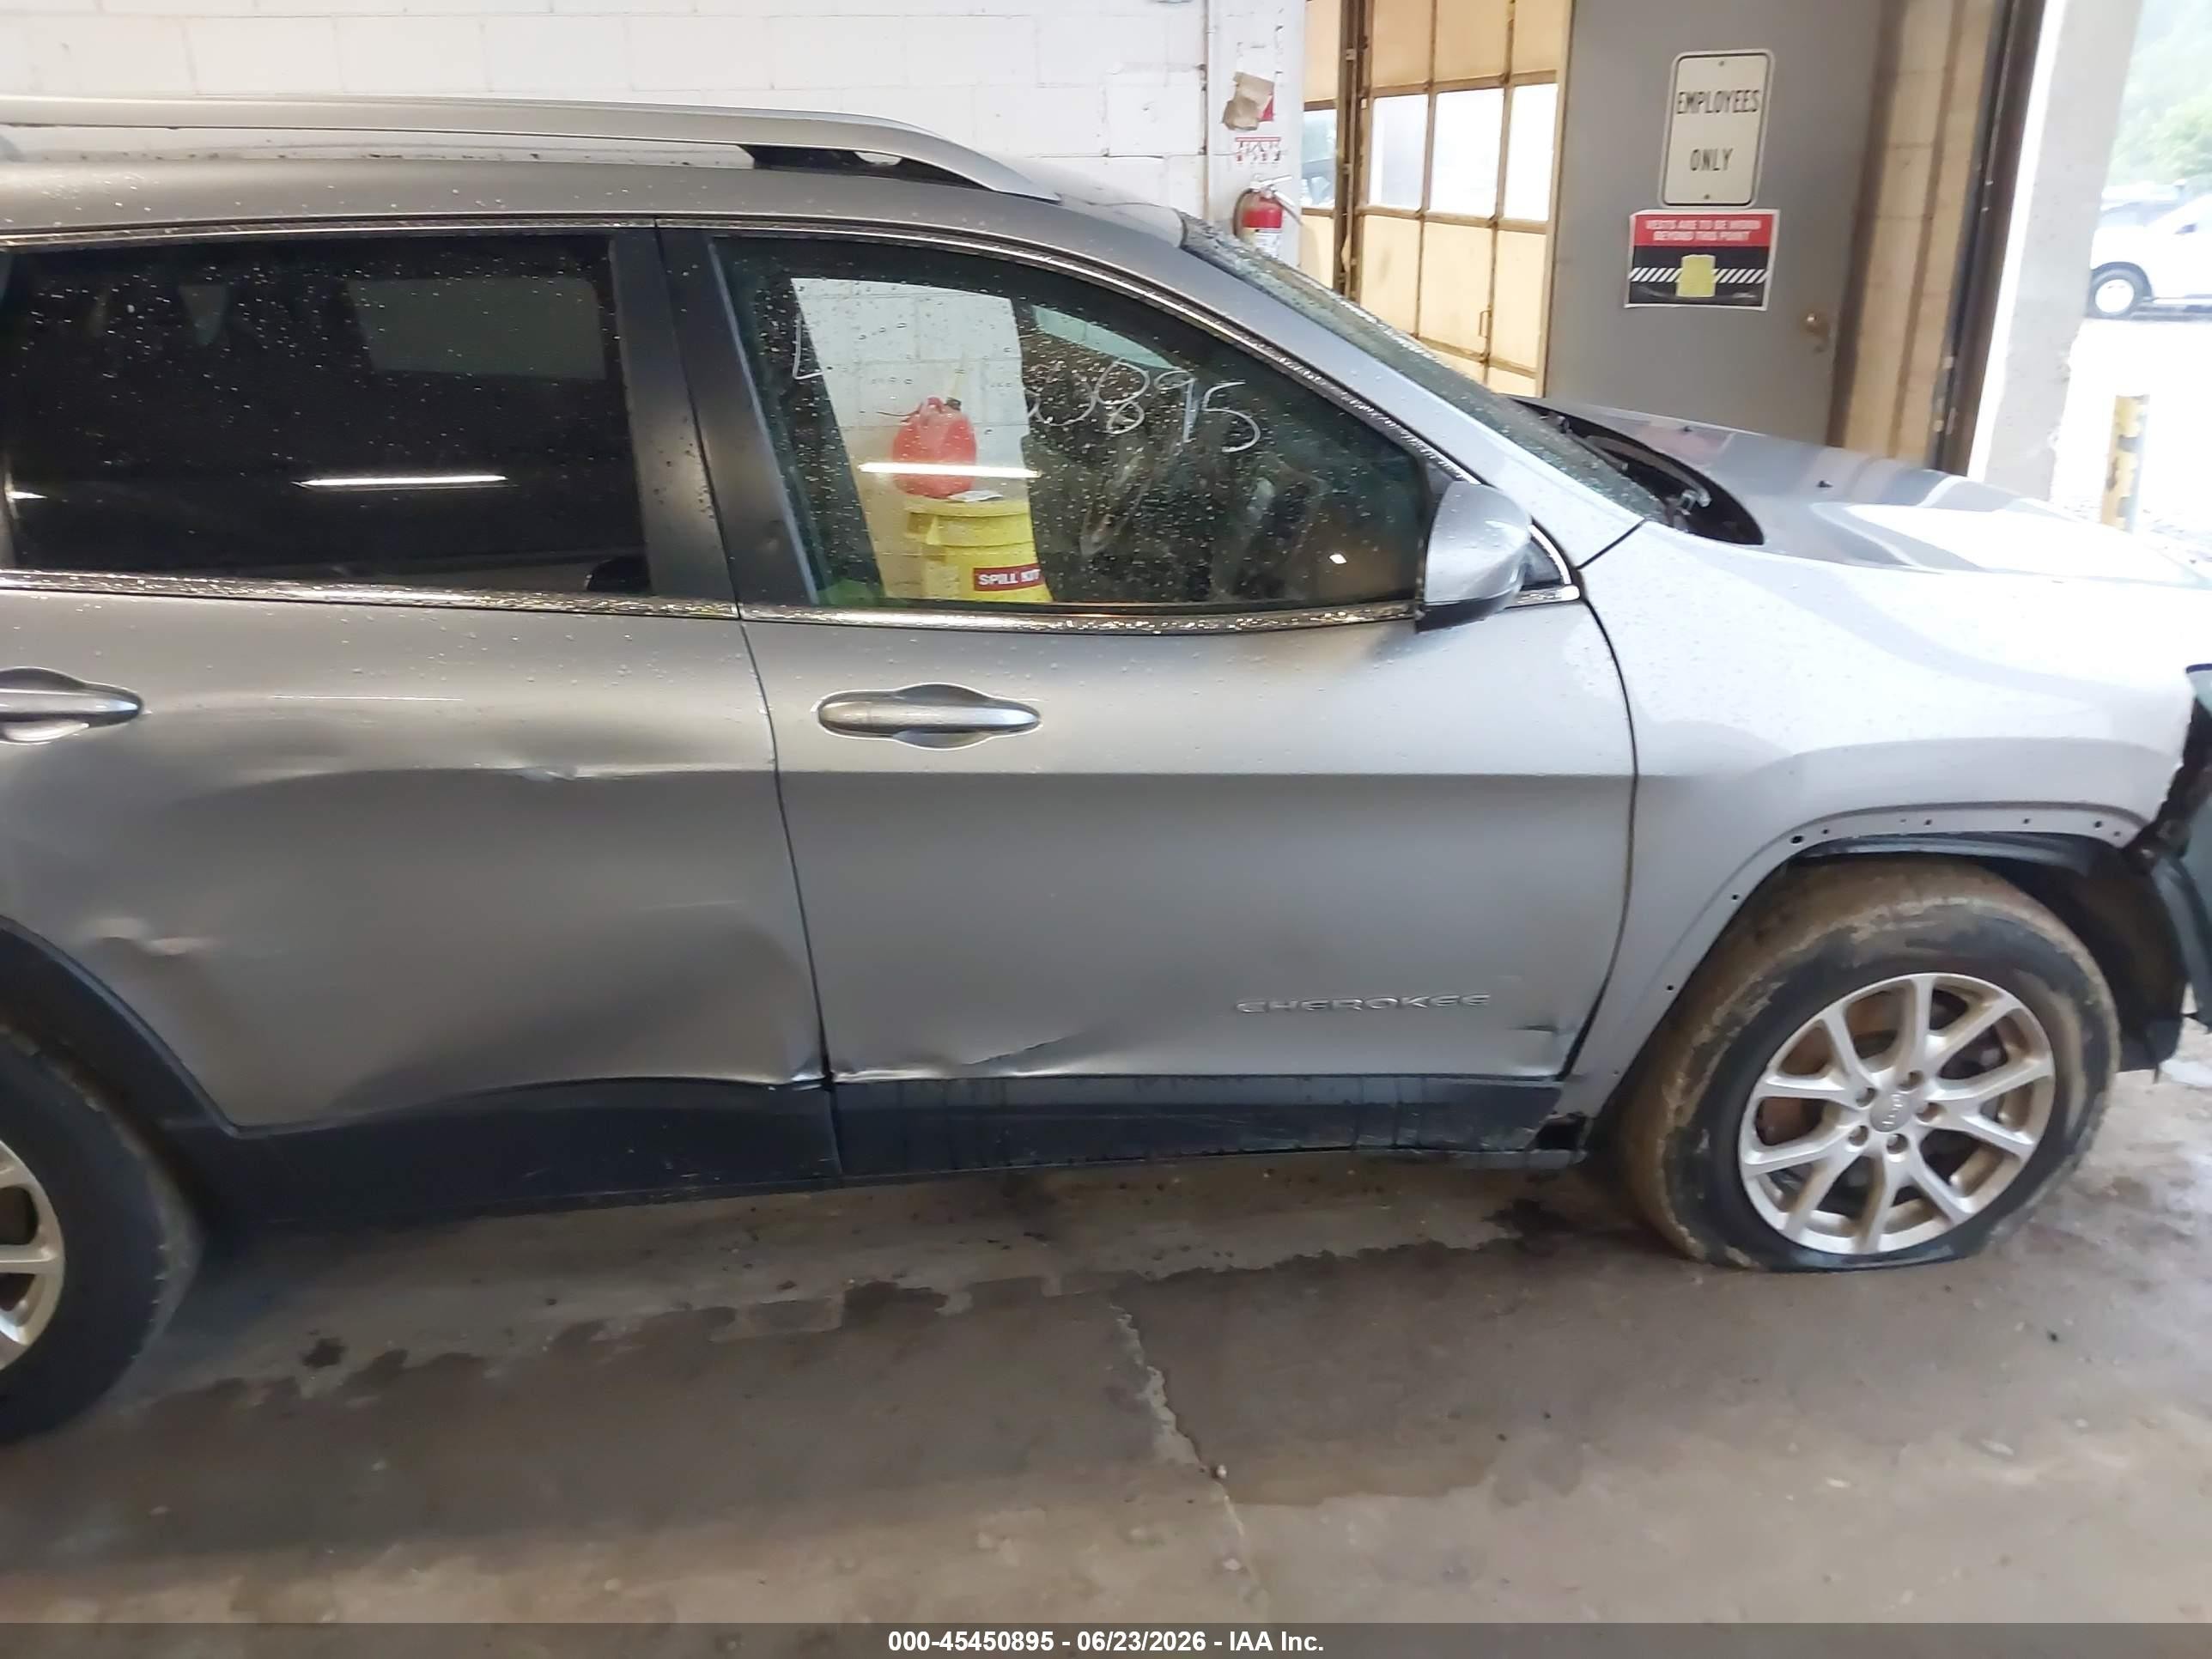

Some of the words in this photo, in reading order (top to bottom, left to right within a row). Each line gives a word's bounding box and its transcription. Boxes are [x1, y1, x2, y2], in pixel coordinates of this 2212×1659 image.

[1676, 89, 1760, 114] EMPLOYEES
[1690, 148, 1733, 172] ONLY
[978, 572, 1018, 586] SPILL
[1236, 994, 1492, 1014] CHEROKEE
